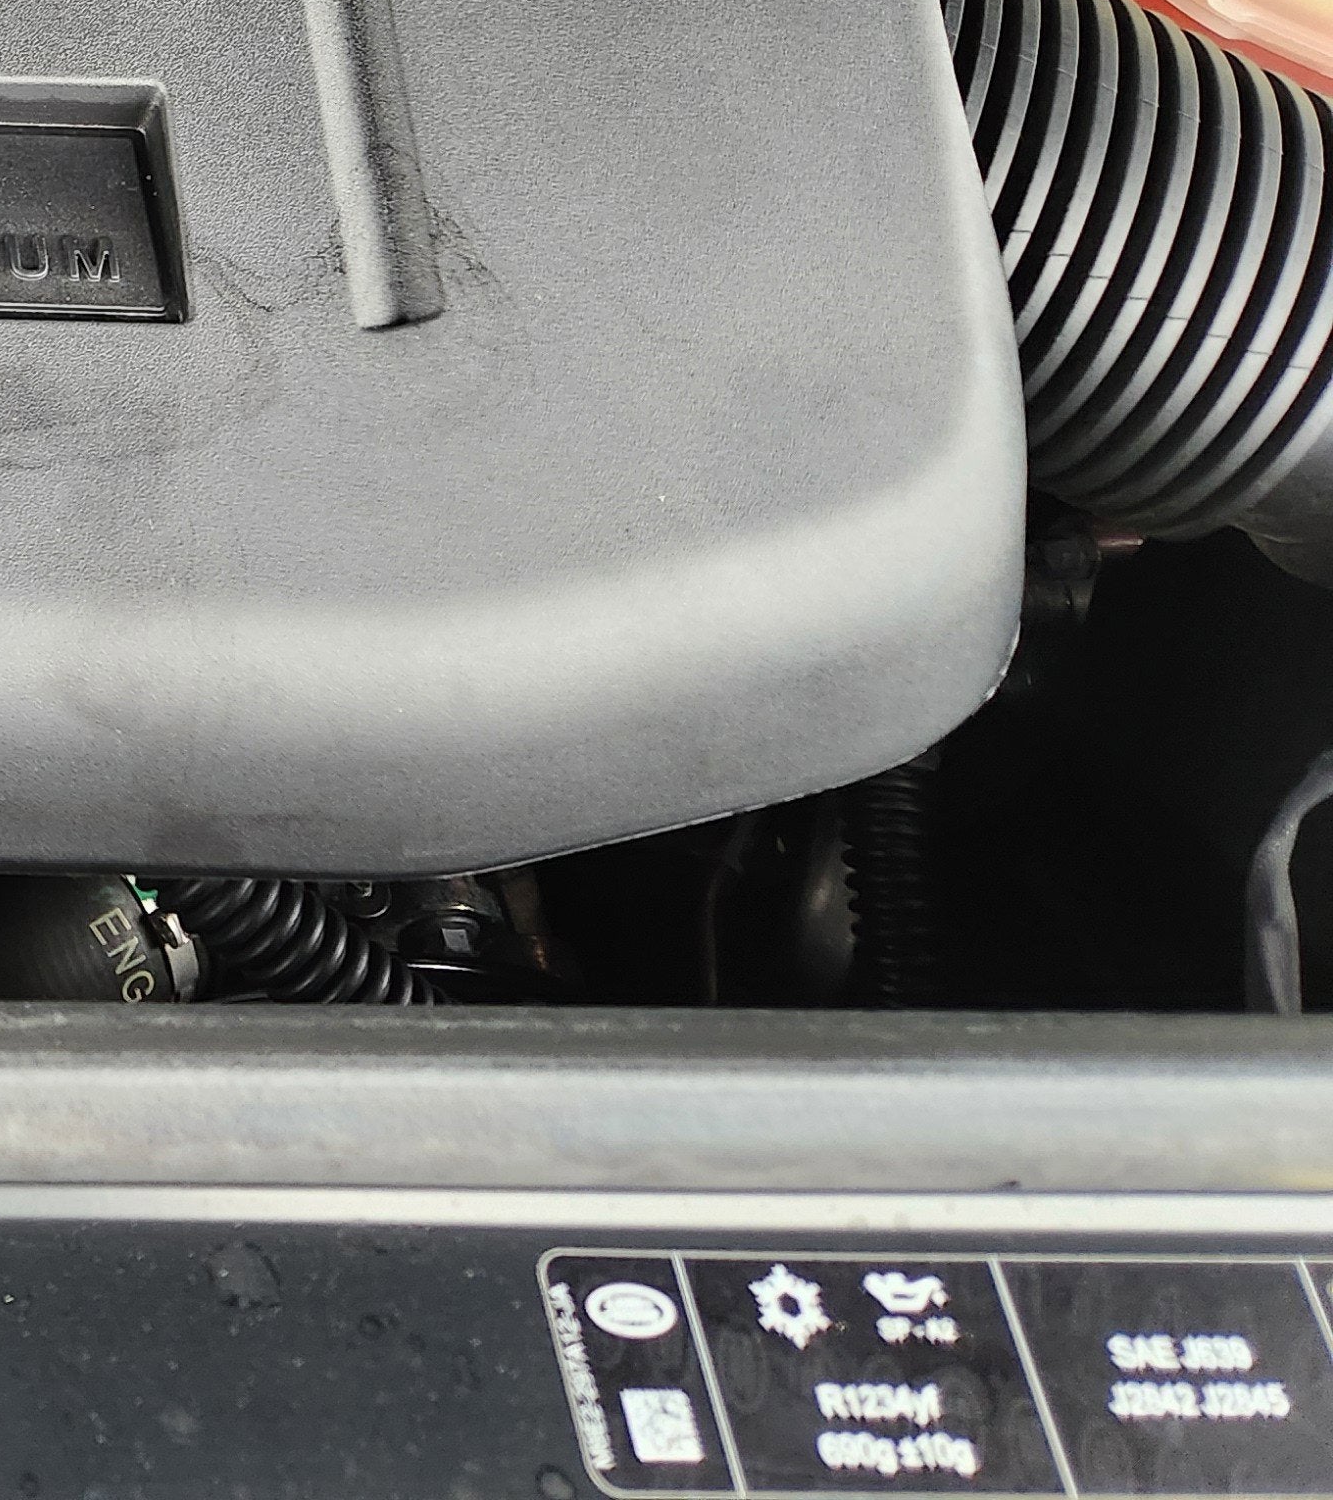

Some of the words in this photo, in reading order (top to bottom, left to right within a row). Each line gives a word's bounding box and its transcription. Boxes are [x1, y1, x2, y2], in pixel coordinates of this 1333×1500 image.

[89, 907, 155, 1003] ENG
[1107, 1333, 1181, 1370] SAE
[814, 1382, 942, 1428] R1234yf
